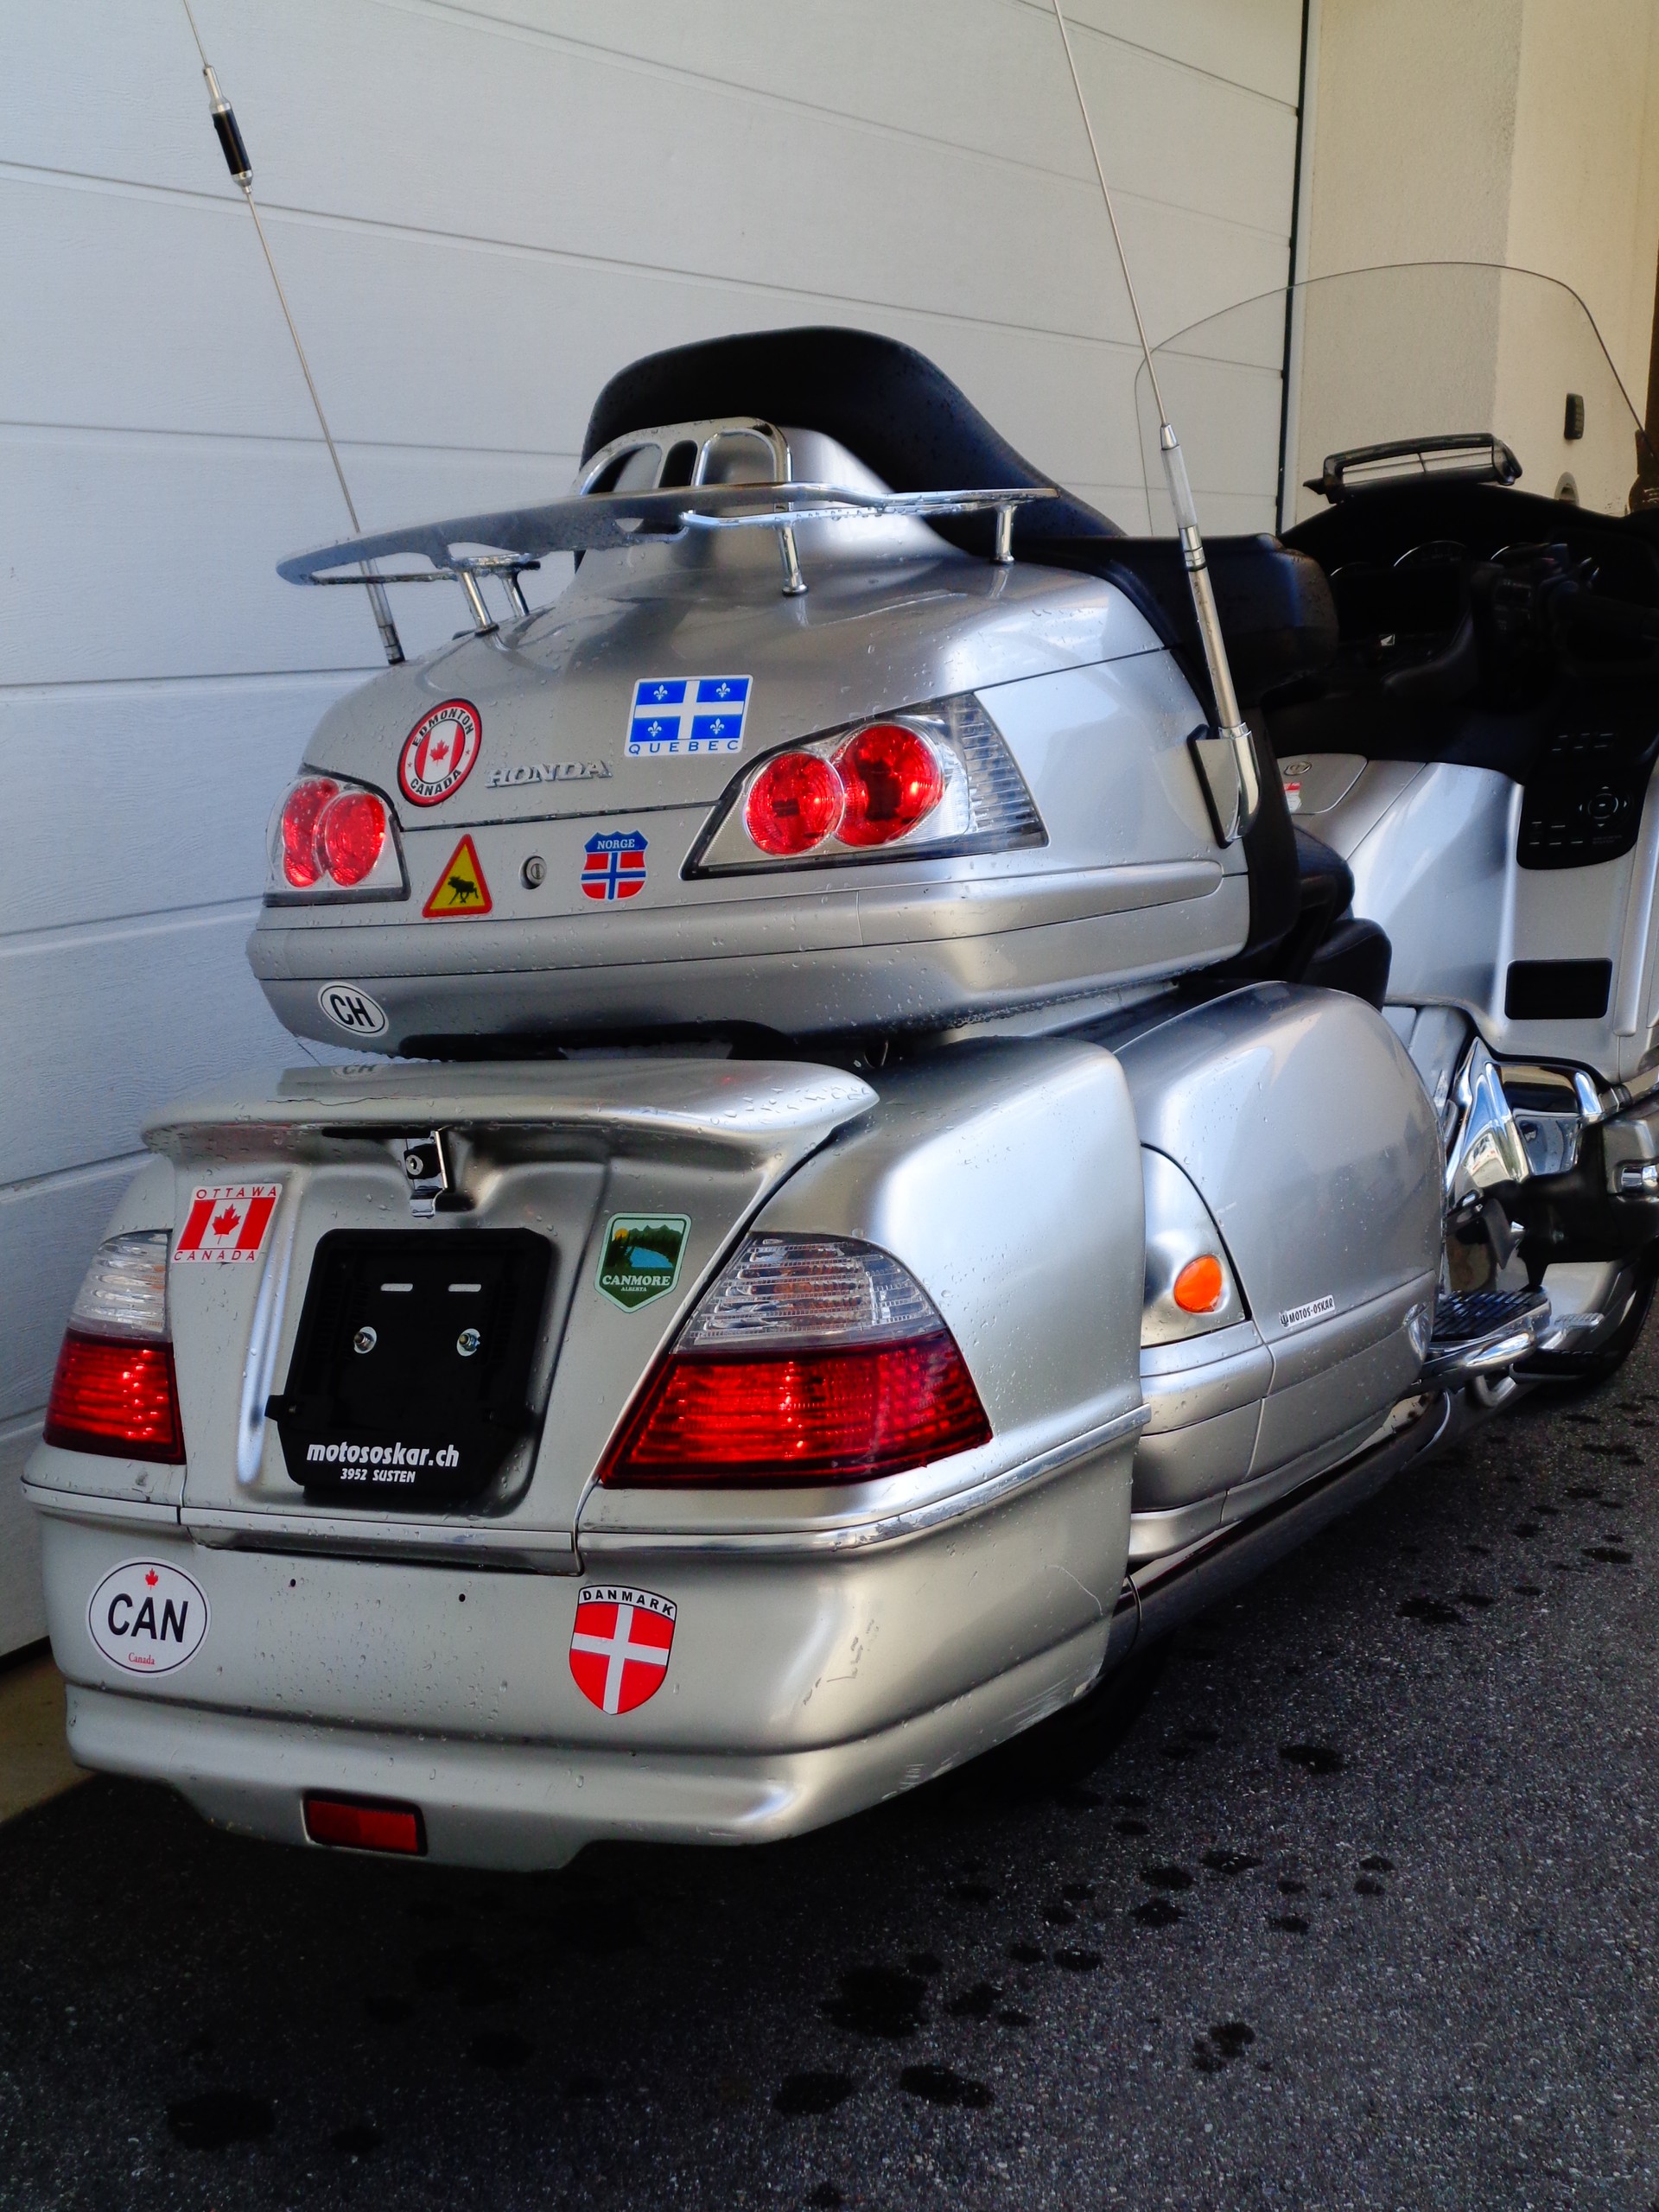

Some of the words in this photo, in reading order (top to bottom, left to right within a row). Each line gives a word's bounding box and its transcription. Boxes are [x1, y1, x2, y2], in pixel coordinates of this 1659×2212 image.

[411, 708, 474, 747] EDMONTON
[628, 740, 739, 755] QUEBEC
[410, 769, 462, 796] CANADA
[485, 760, 613, 788] HONDA
[597, 838, 635, 850] NORGE
[330, 994, 376, 1027] CH
[196, 1186, 276, 1199] OTTAWA
[174, 1250, 255, 1261] CANADA
[602, 1274, 671, 1287] CANMORE
[1288, 1298, 1334, 1324] MOTOS-OSKAR
[306, 1441, 460, 1467] motososkar.ch
[340, 1468, 368, 1481] 3952
[372, 1470, 416, 1483] SUSTEN
[582, 1590, 674, 1616] DANMARK
[108, 1593, 188, 1643] CAN
[128, 1652, 155, 1665] Canada
